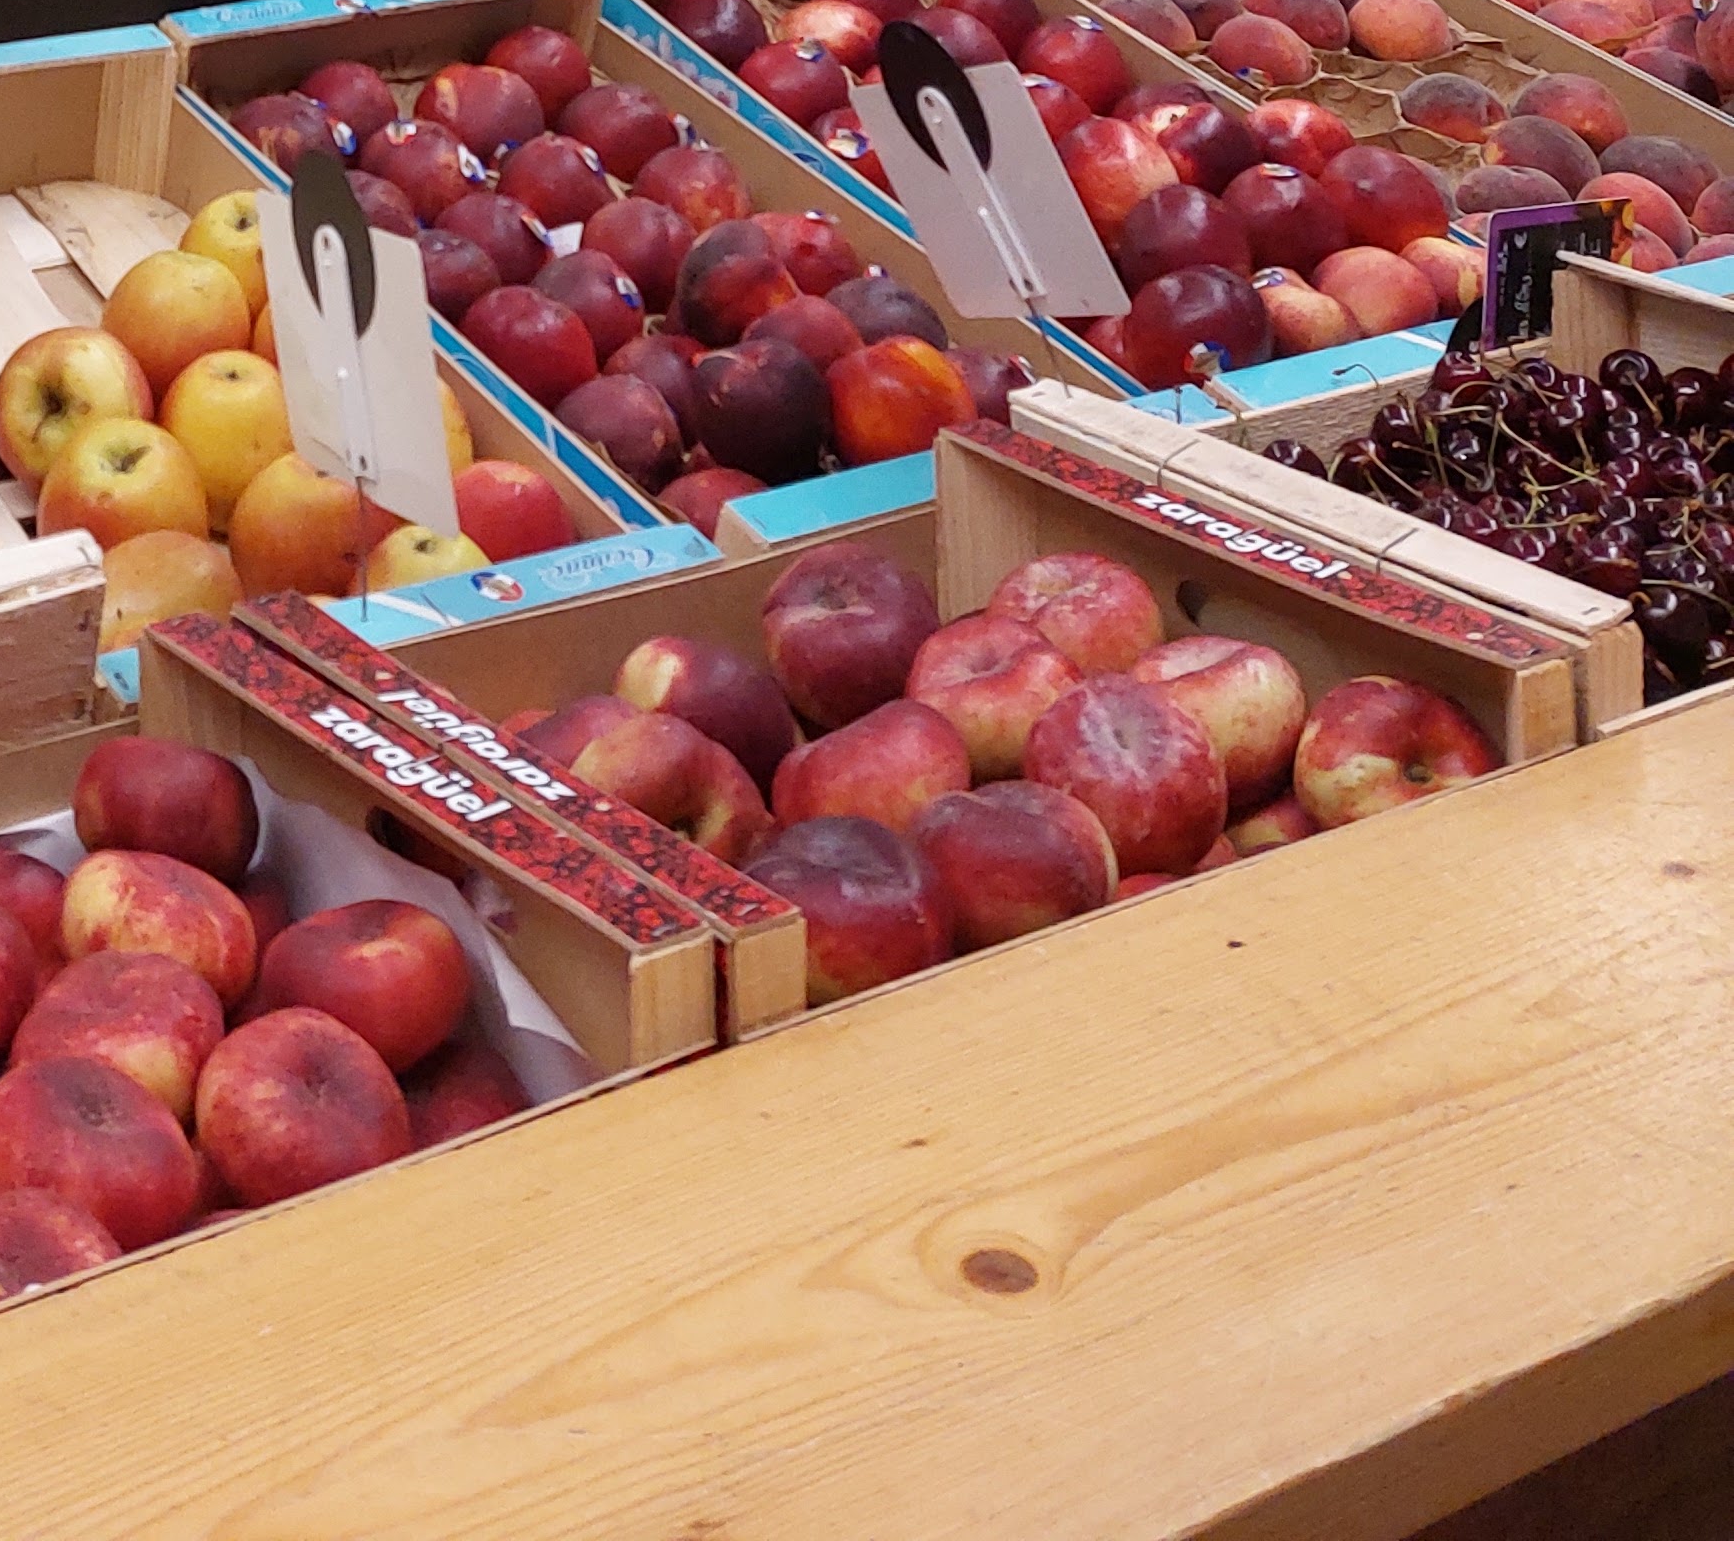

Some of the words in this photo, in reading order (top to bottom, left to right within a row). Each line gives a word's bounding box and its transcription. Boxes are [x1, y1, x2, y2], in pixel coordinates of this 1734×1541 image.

[1132, 491, 1350, 579] zaragüel
[310, 705, 513, 823] zaragüel
[376, 689, 578, 802] zaragüel
